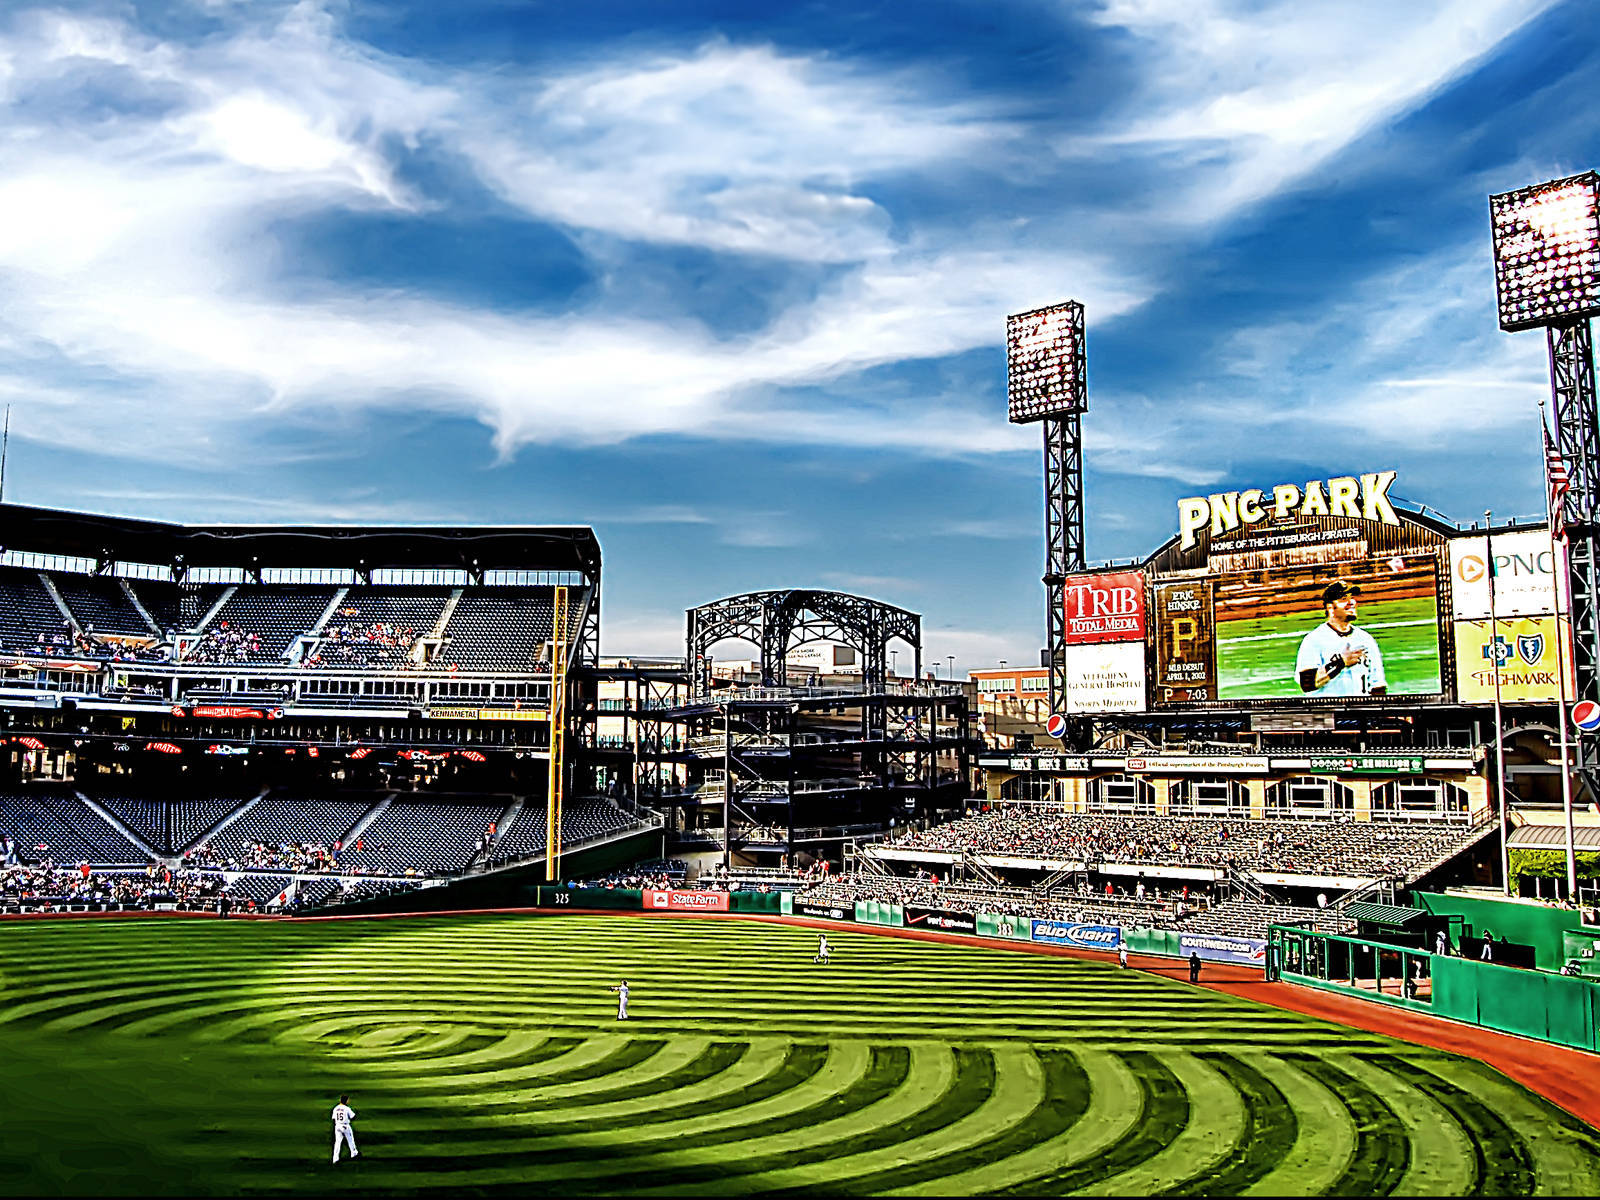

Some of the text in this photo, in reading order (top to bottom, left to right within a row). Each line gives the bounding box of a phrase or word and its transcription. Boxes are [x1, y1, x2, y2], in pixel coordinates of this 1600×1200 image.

[1177, 471, 1400, 552] PNC PARK
[1210, 528, 1360, 552] HOME OF THE PITTSBURGH PIRATES
[1494, 551, 1553, 577] PNC
[1066, 584, 1138, 618] TRIB
[1172, 590, 1194, 601] ERIC
[1069, 617, 1139, 633] TOTAL MEDIA
[1185, 689, 1208, 701] 7:03
[430, 709, 477, 719] KENNAMETAL
[555, 893, 569, 904] 325
